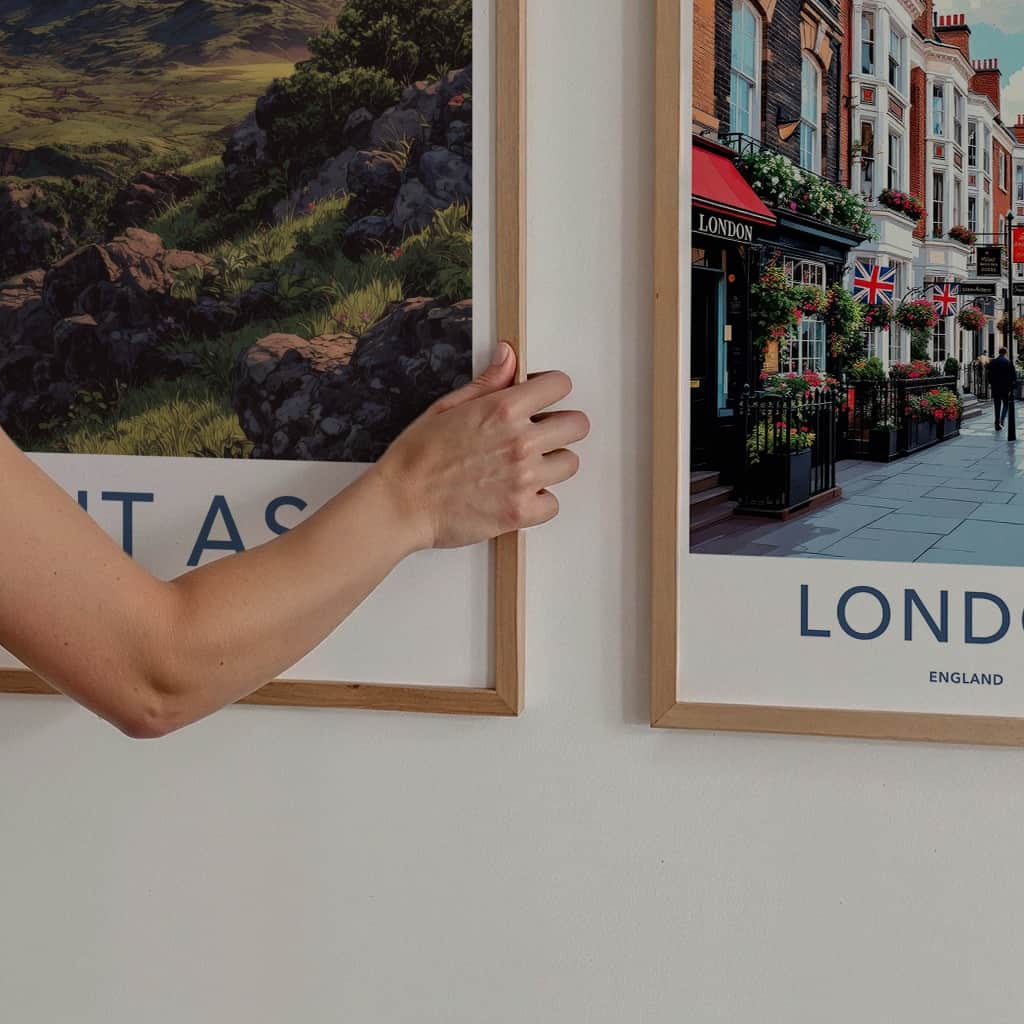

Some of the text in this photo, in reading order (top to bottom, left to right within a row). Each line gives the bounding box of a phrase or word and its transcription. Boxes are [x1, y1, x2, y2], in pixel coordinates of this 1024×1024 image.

[698, 213, 753, 242] LONDON
[800, 583, 1024, 645] LOND
[929, 671, 1004, 686] ENGLAND
